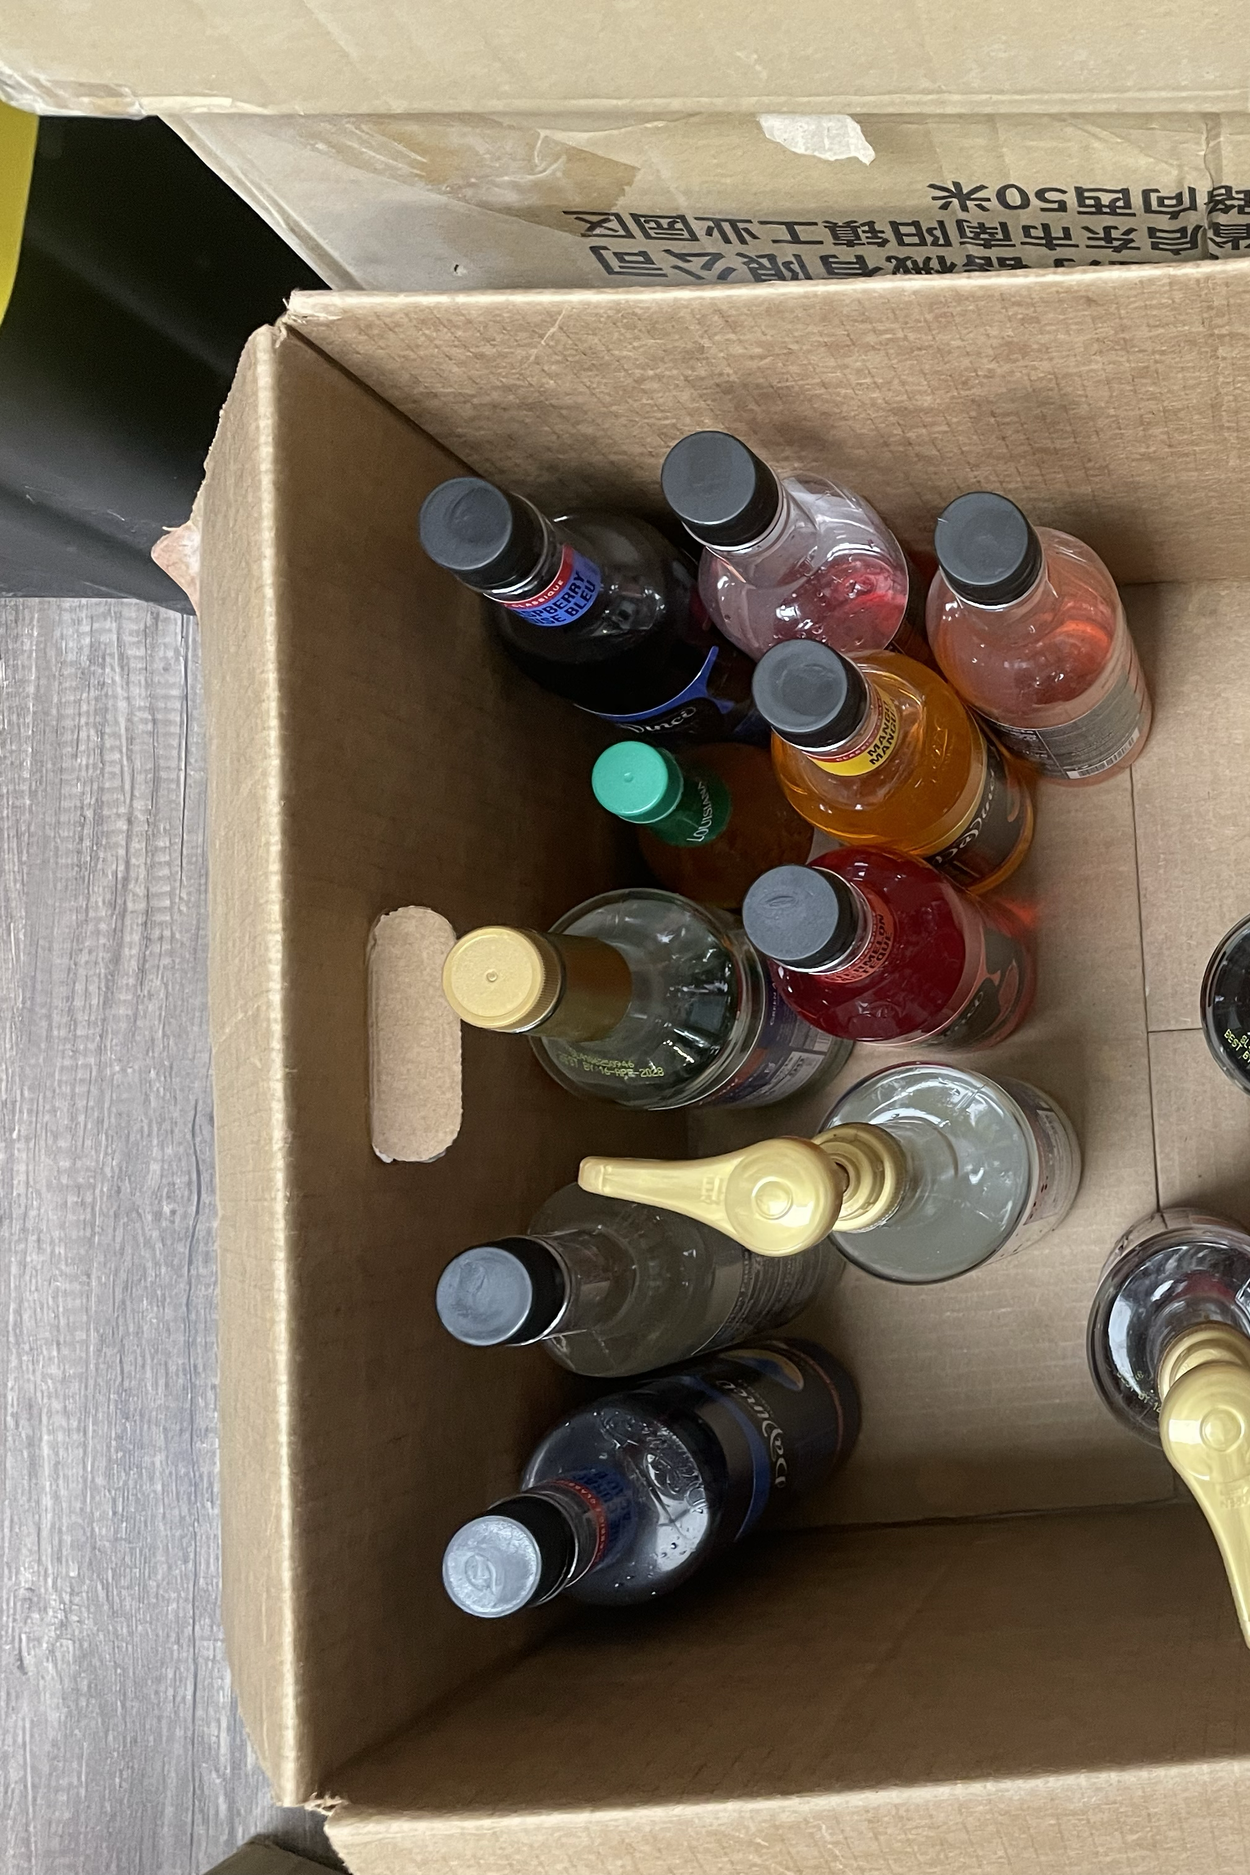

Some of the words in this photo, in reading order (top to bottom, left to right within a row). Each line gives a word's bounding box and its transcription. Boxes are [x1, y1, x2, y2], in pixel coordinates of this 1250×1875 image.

[565, 580, 597, 617] BLEU
[686, 781, 714, 841] LOUISIANA
[1223, 1029, 1242, 1051] BEST
[716, 1380, 786, 1487] DaVinci
